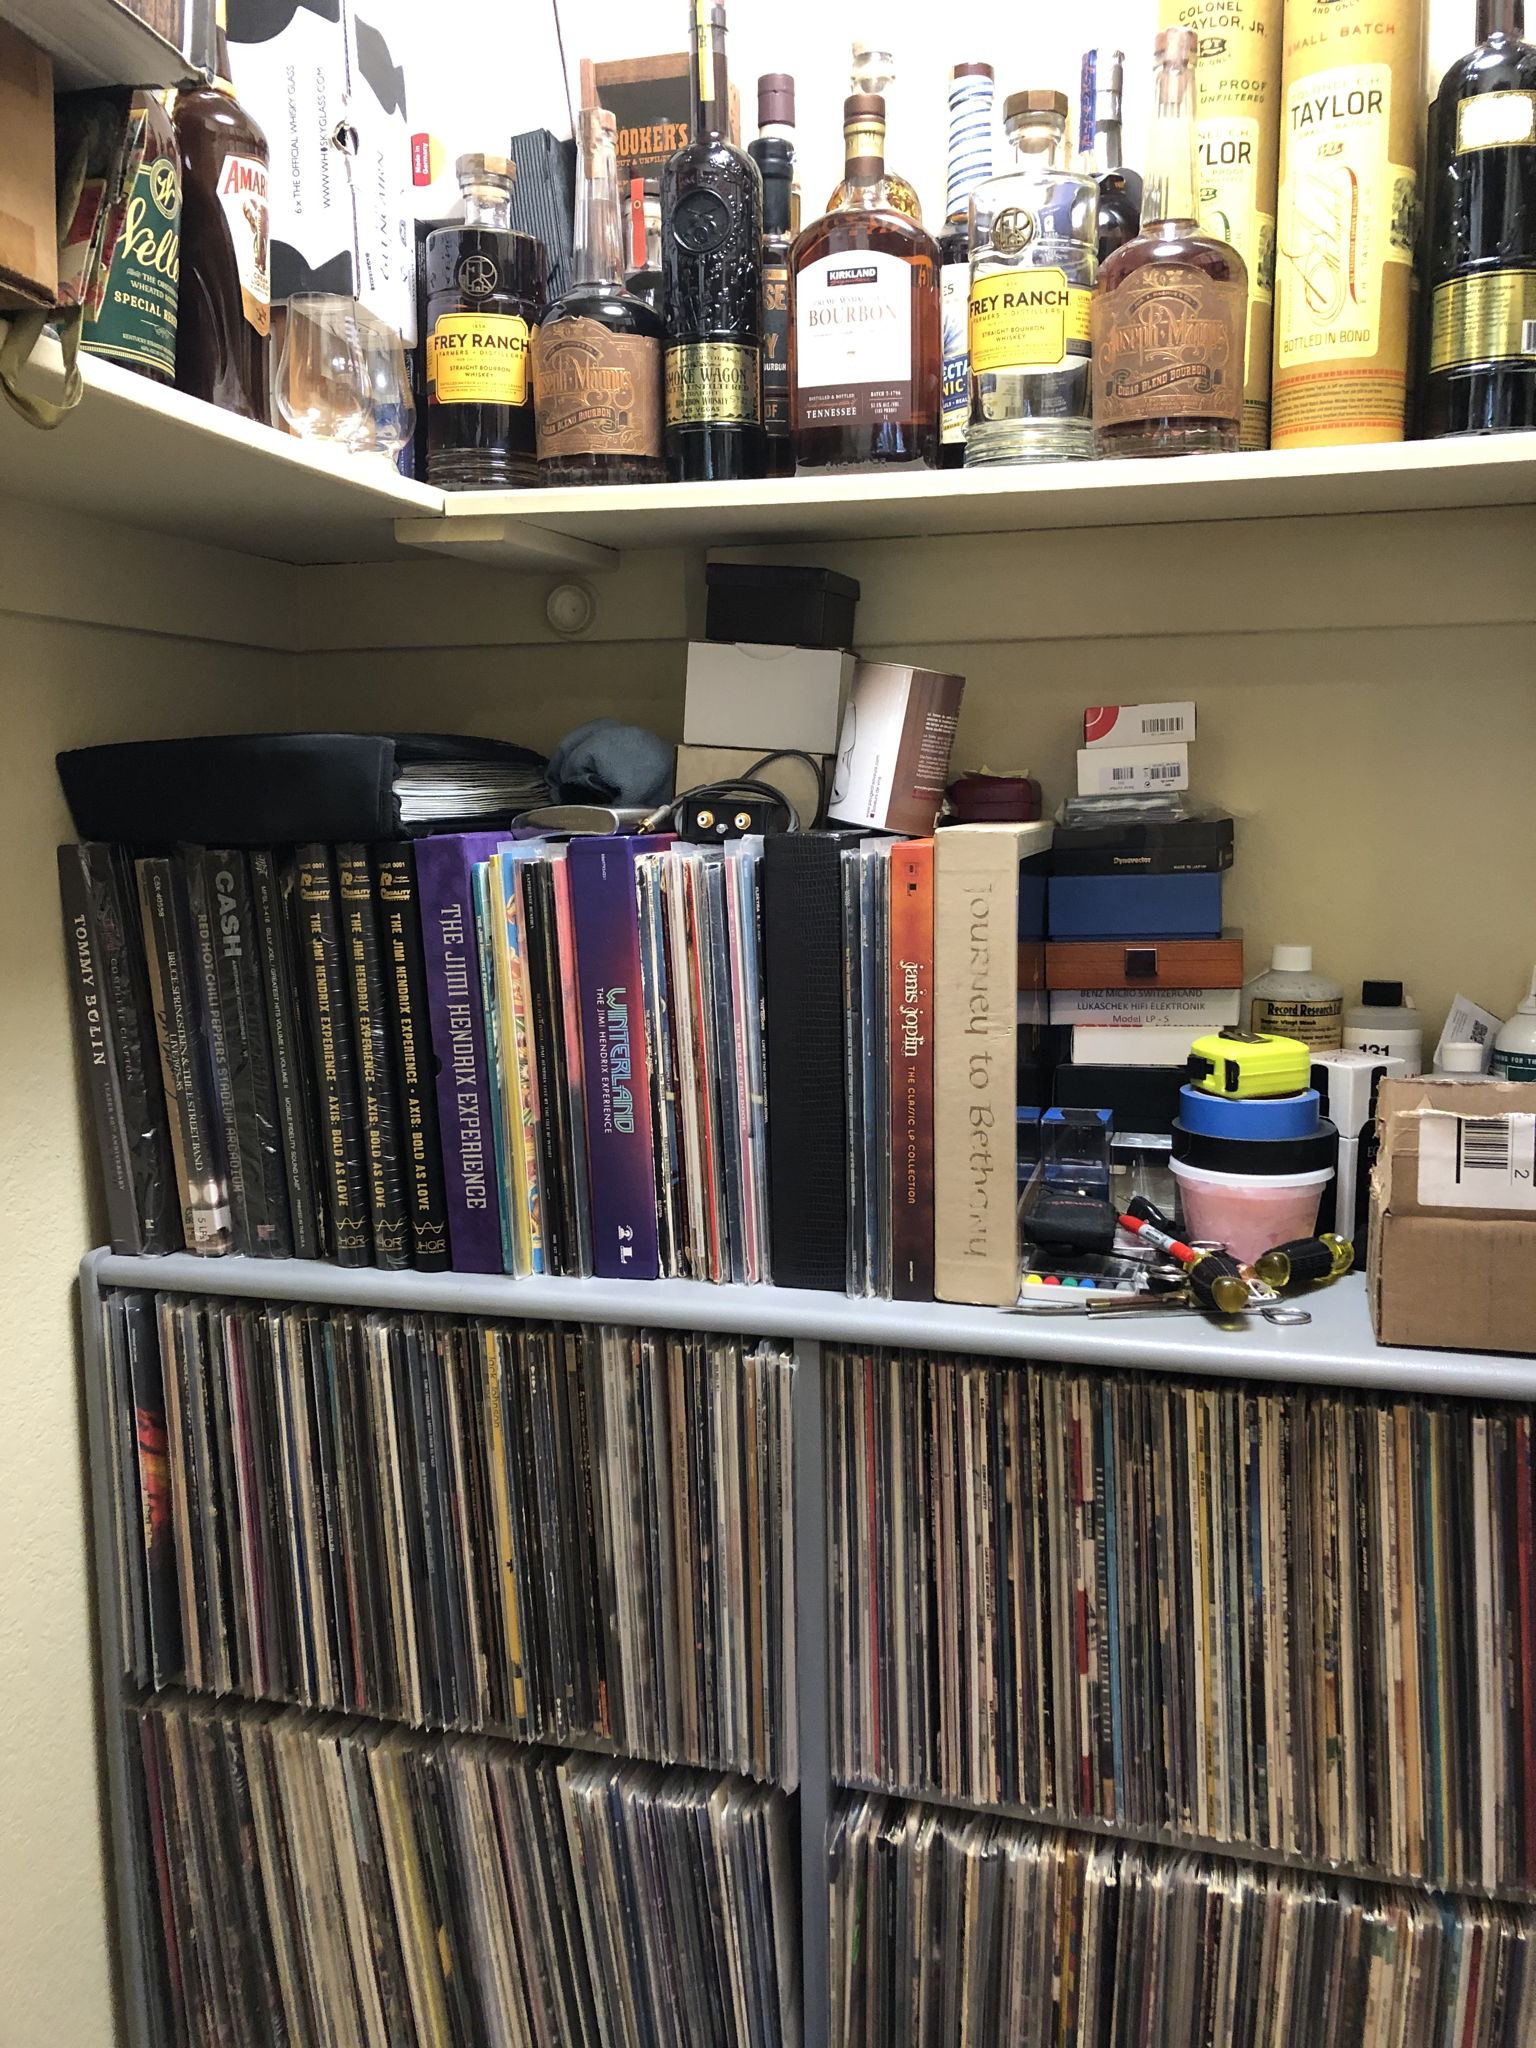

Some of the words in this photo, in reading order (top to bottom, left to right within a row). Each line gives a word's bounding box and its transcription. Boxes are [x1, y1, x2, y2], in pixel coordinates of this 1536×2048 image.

[1179, 1, 1243, 21] COLONEL
[1249, 20, 1267, 37] JR.
[1287, 34, 1327, 57] SMALL
[1340, 23, 1396, 37] BATCH
[286, 65, 296, 96] GLASS
[1219, 80, 1267, 91] PROOF
[1200, 93, 1265, 104] UNFILTERED
[1291, 90, 1383, 130] TAYLOR
[288, 96, 299, 137] WHISKY
[291, 138, 300, 177] OFFICIAL
[293, 178, 301, 198] THE
[295, 206, 302, 214] 6
[829, 268, 876, 280] KIRKLAND
[114, 291, 161, 317] SPECIAL
[809, 305, 897, 327] BOURBON
[970, 295, 999, 318] FREY
[1003, 291, 1069, 308] RANCH
[972, 312, 1000, 324] FARMERS
[1011, 308, 1061, 317] DISTILLERS
[434, 334, 468, 350] FREY
[472, 334, 531, 353] RANCH
[982, 328, 1009, 338] STRAIGHT
[1010, 325, 1045, 334] BOURBON
[996, 334, 1026, 342] WHISKEY
[1284, 334, 1321, 352] BOTTLED
[1325, 333, 1336, 343] IN
[1339, 330, 1370, 342] BOND
[480, 350, 523, 359] DISTILLERS
[700, 368, 746, 384] WAGON
[1141, 374, 1168, 391] BLEND
[1170, 365, 1207, 381] BOURBON
[806, 407, 857, 419] TENNESSEE
[1113, 857, 1152, 865] Dynavector
[197, 914, 209, 940] RED
[215, 870, 242, 957] CASH
[310, 912, 321, 933] THE
[350, 912, 361, 933] THE
[390, 912, 401, 934] THE
[439, 904, 463, 946] THE
[265, 928, 273, 945] BILLY
[312, 938, 324, 961] JIMI
[352, 937, 364, 961] JIMI
[392, 938, 404, 962] JIMI
[167, 951, 179, 982] BRUCE
[201, 942, 213, 971] HOT
[478, 944, 487, 972] HENDRIX
[270, 968, 280, 1001] GREATEST
[444, 950, 469, 997] JIMI
[899, 960, 924, 1004] janis
[73, 913, 96, 987] TOMMY
[85, 994, 106, 1066] BOLIN
[205, 973, 219, 1006] CHILI
[314, 965, 330, 1012] HENDRIX
[355, 964, 370, 1012] HENDRIX
[395, 965, 410, 1014] HENDRIX
[481, 973, 490, 1011] EXPERIENCE
[596, 988, 604, 1005] THE
[1080, 990, 1104, 998] BENZ
[1105, 990, 1136, 998] MICRO
[1138, 989, 1203, 998] SWITZERLAND
[273, 1002, 281, 1018] HITS
[597, 1009, 606, 1026] JIMI
[1077, 1003, 1129, 1011] LUKASCHEK
[1150, 1002, 1205, 1010] ELEKTRONIK
[1112, 1015, 1141, 1023] Model
[1145, 1015, 1156, 1023] LP
[1267, 1003, 1298, 1016] Record
[1300, 1003, 1333, 1016] Research
[171, 986, 188, 1058] SPRINGSTEEN
[275, 1018, 285, 1045] VOLUME
[899, 1005, 925, 1058] joplin
[209, 1009, 226, 1064] PEPPERS
[320, 1016, 336, 1082] EXPERIENCE
[360, 1016, 375, 1083] EXPERIENCE
[450, 1004, 477, 1086] HENDRIX
[400, 1017, 416, 1085] EXPERIENCE
[598, 1031, 608, 1073] HENDRIX
[606, 987, 635, 1134] WINTERLAND
[280, 1056, 289, 1083] VOLUME
[907, 1066, 915, 1084] THE
[969, 1050, 993, 1090] to
[215, 1067, 233, 1123] STADIUM
[284, 1097, 293, 1120] MOBILE
[601, 1076, 612, 1134] EXPERIENCE
[908, 1086, 916, 1127] CLASSIC
[187, 1100, 199, 1140] STREET
[329, 1095, 340, 1125] AXIS:
[367, 1096, 379, 1126] AXIS:
[408, 1098, 420, 1128] AXIS:
[287, 1122, 296, 1149] FIDELITY
[332, 1129, 344, 1156] BOLD
[370, 1130, 383, 1157] BOLD
[411, 1132, 424, 1160] BOLD
[908, 1130, 916, 1140] LP
[192, 1142, 204, 1171] BAND
[223, 1127, 242, 1193] ARCADIUM
[290, 1151, 298, 1174] SOUND
[457, 1093, 487, 1210] EXPERIENCE
[335, 1161, 345, 1176] AS
[372, 1162, 383, 1177] AS
[415, 1164, 426, 1180] AS
[908, 1144, 917, 1205] COLLECTION
[336, 1180, 349, 1207] LOVE
[374, 1181, 387, 1209] LOVE
[417, 1183, 430, 1211] LOVE
[490, 1384, 501, 1428] Johnson
[1102, 1703, 1111, 1742] STARS
